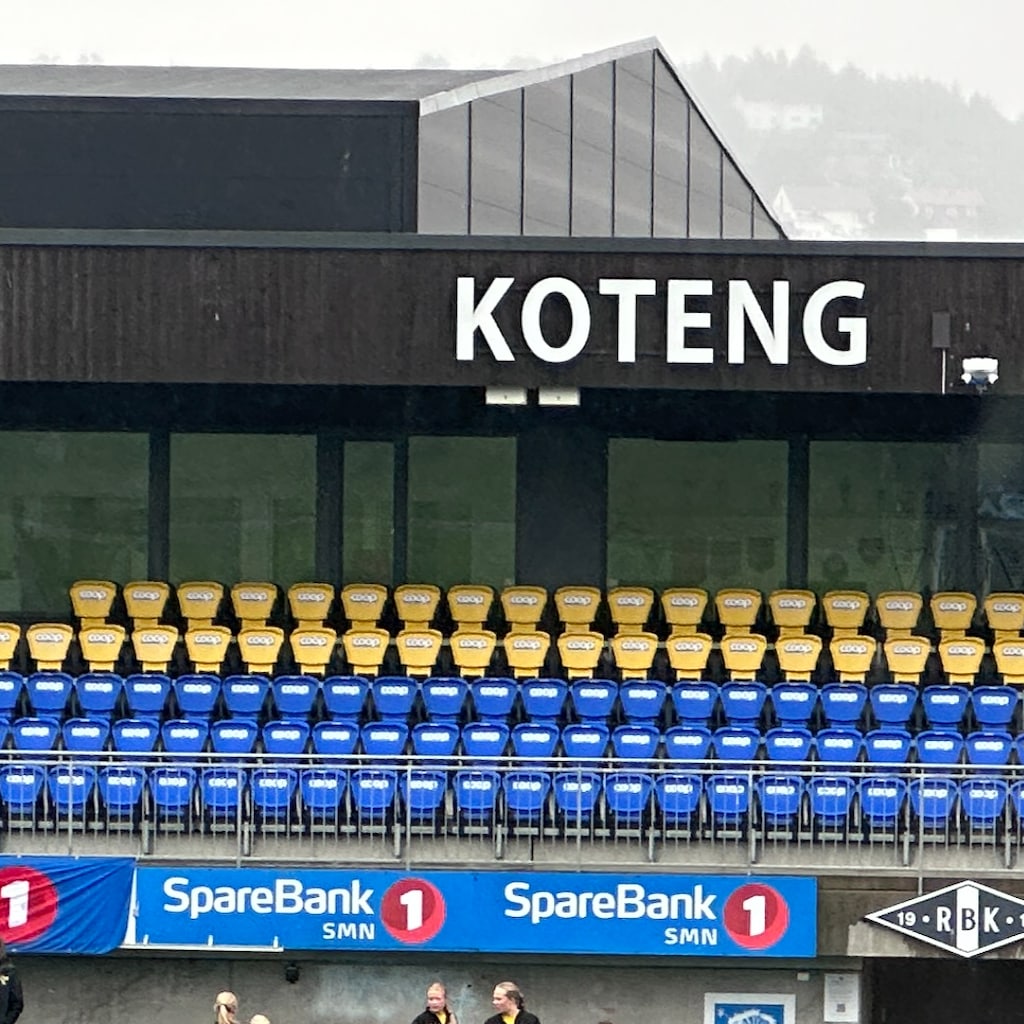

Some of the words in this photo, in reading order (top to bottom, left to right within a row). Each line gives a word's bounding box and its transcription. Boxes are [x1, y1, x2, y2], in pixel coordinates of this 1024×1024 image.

[456, 277, 867, 366] KOTENG
[1, 880, 30, 928] 1
[163, 877, 374, 919] SpareBank
[399, 889, 423, 931] 1
[504, 882, 717, 924] SpareBank
[742, 895, 766, 937] 1
[898, 912, 917, 926] 19
[936, 906, 1000, 933] RBK
[323, 922, 375, 940] SMN
[665, 927, 717, 946] SMN
